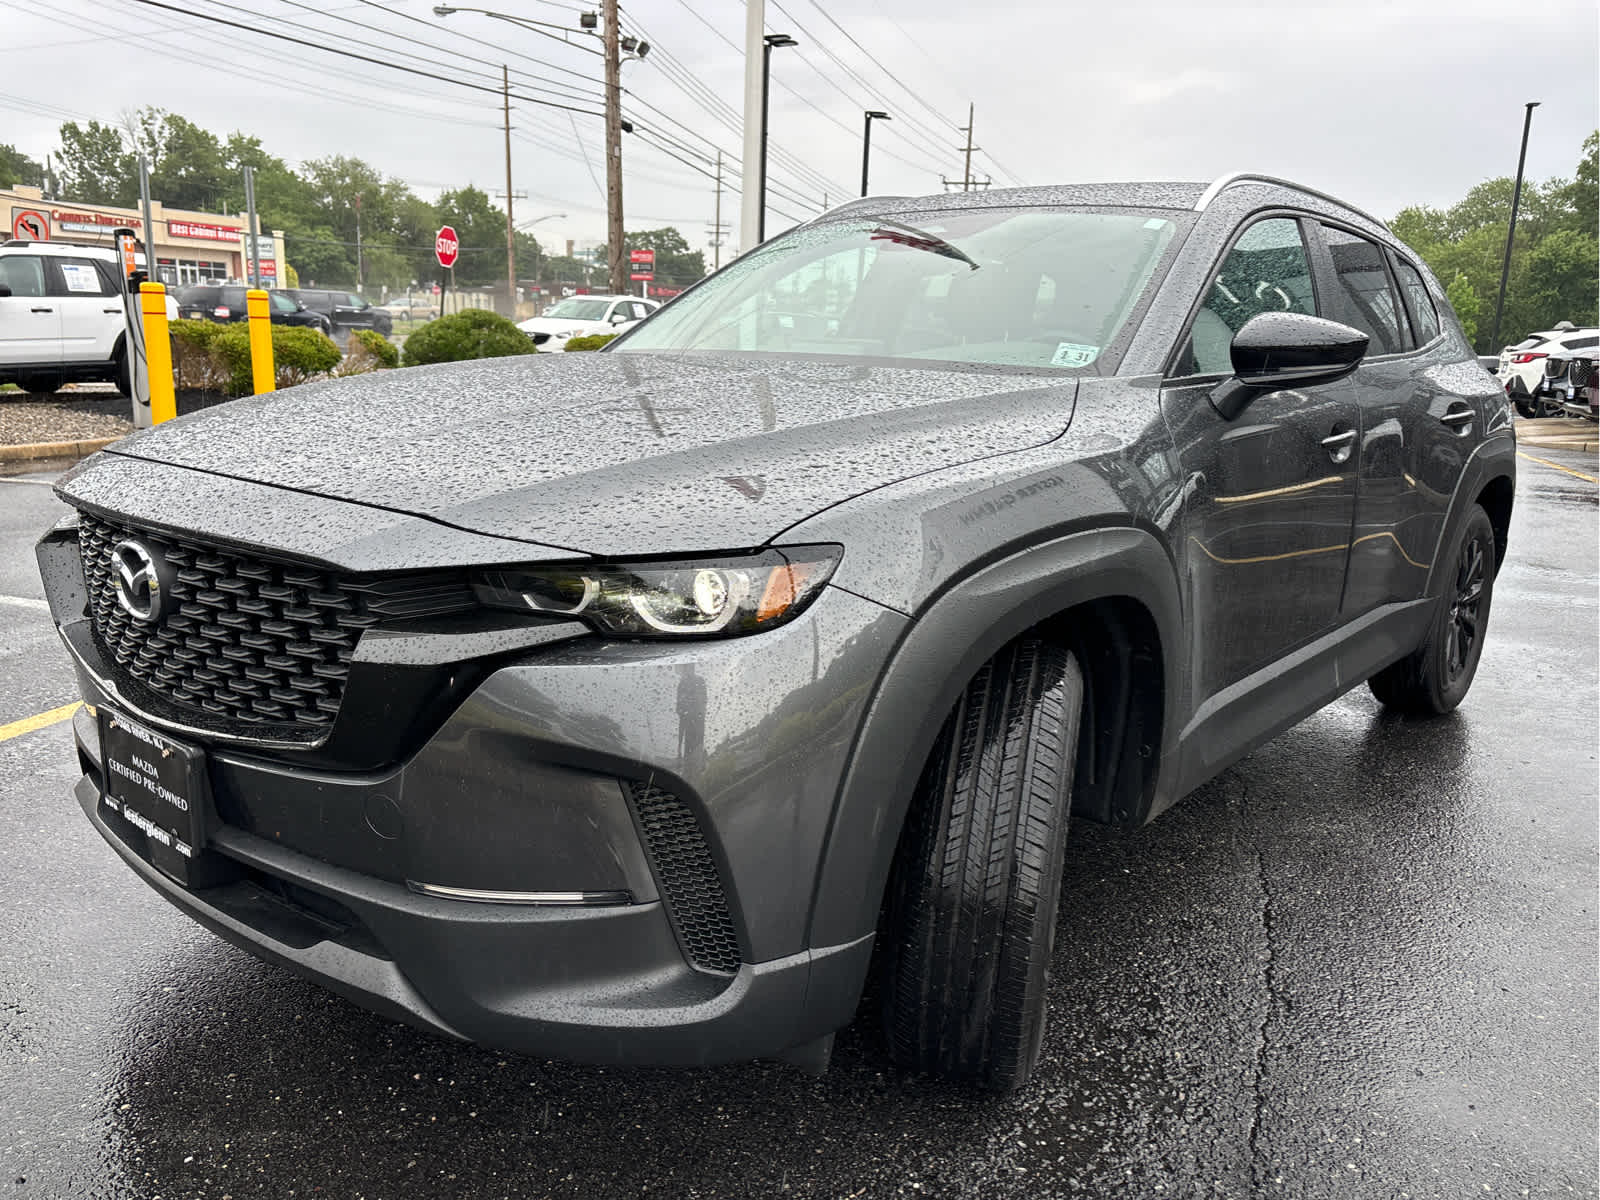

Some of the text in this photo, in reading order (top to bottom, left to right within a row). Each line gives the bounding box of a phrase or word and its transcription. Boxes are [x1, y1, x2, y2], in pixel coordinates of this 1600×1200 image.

[437, 237, 457, 256] STOP
[132, 753, 159, 780] MAZDA
[108, 757, 188, 812] CERTIFIED PRE-OWNED
[123, 803, 170, 847] lesterglenn
